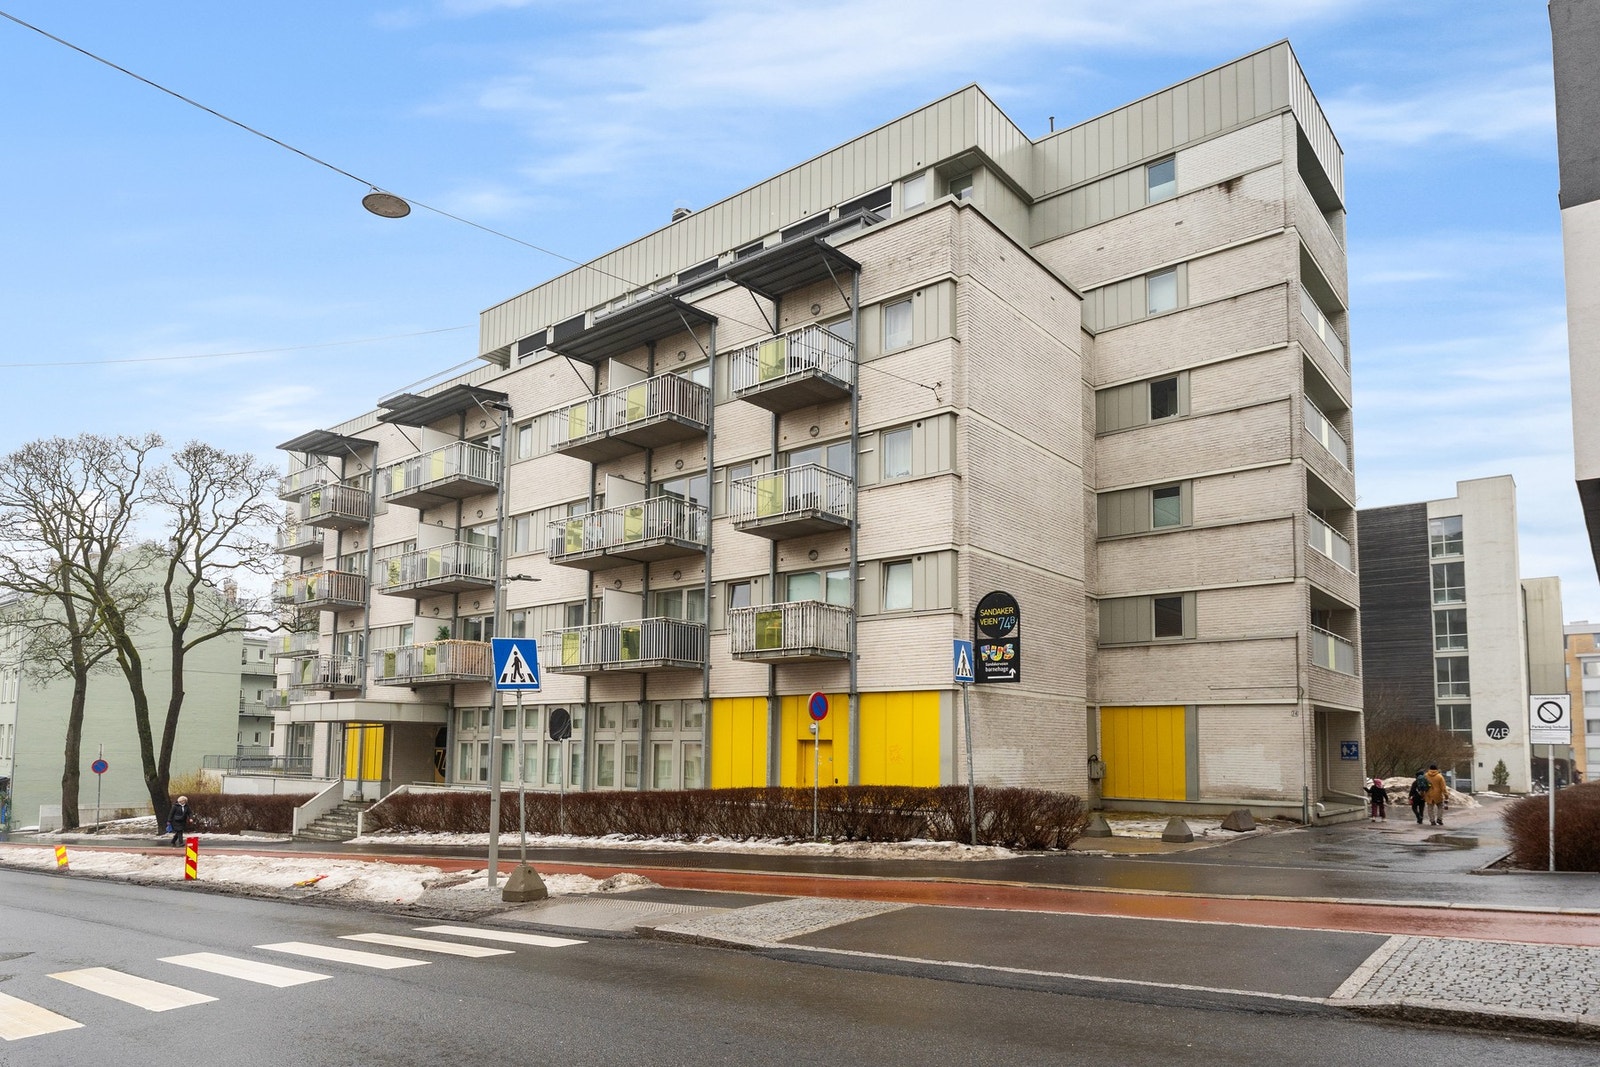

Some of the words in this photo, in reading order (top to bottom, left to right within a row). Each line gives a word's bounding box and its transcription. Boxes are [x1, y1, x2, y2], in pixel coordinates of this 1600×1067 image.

[980, 607, 1013, 616] SANDAKER
[980, 618, 998, 626] VEIEN
[999, 616, 1015, 630] 74B
[981, 643, 1015, 661] FUS
[1488, 728, 1509, 739] 74B
